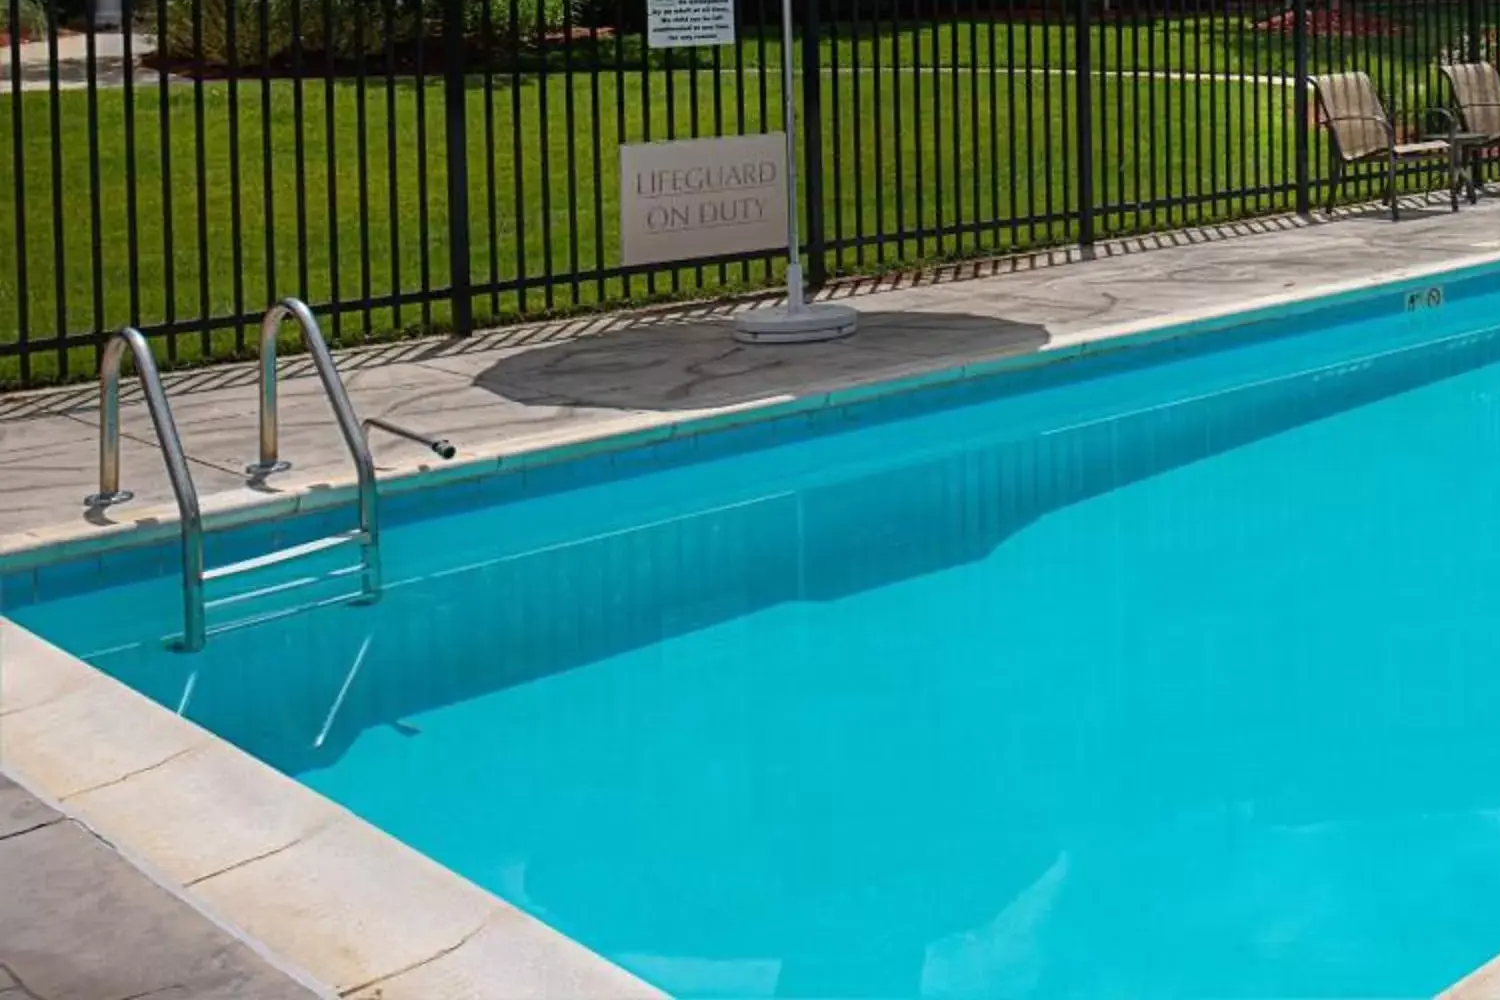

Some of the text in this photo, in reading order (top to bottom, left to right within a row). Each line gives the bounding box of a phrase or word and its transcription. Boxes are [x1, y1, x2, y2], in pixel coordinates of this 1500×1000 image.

[636, 160, 777, 195] LIFEGUARD
[646, 197, 768, 230] ON DUTY
